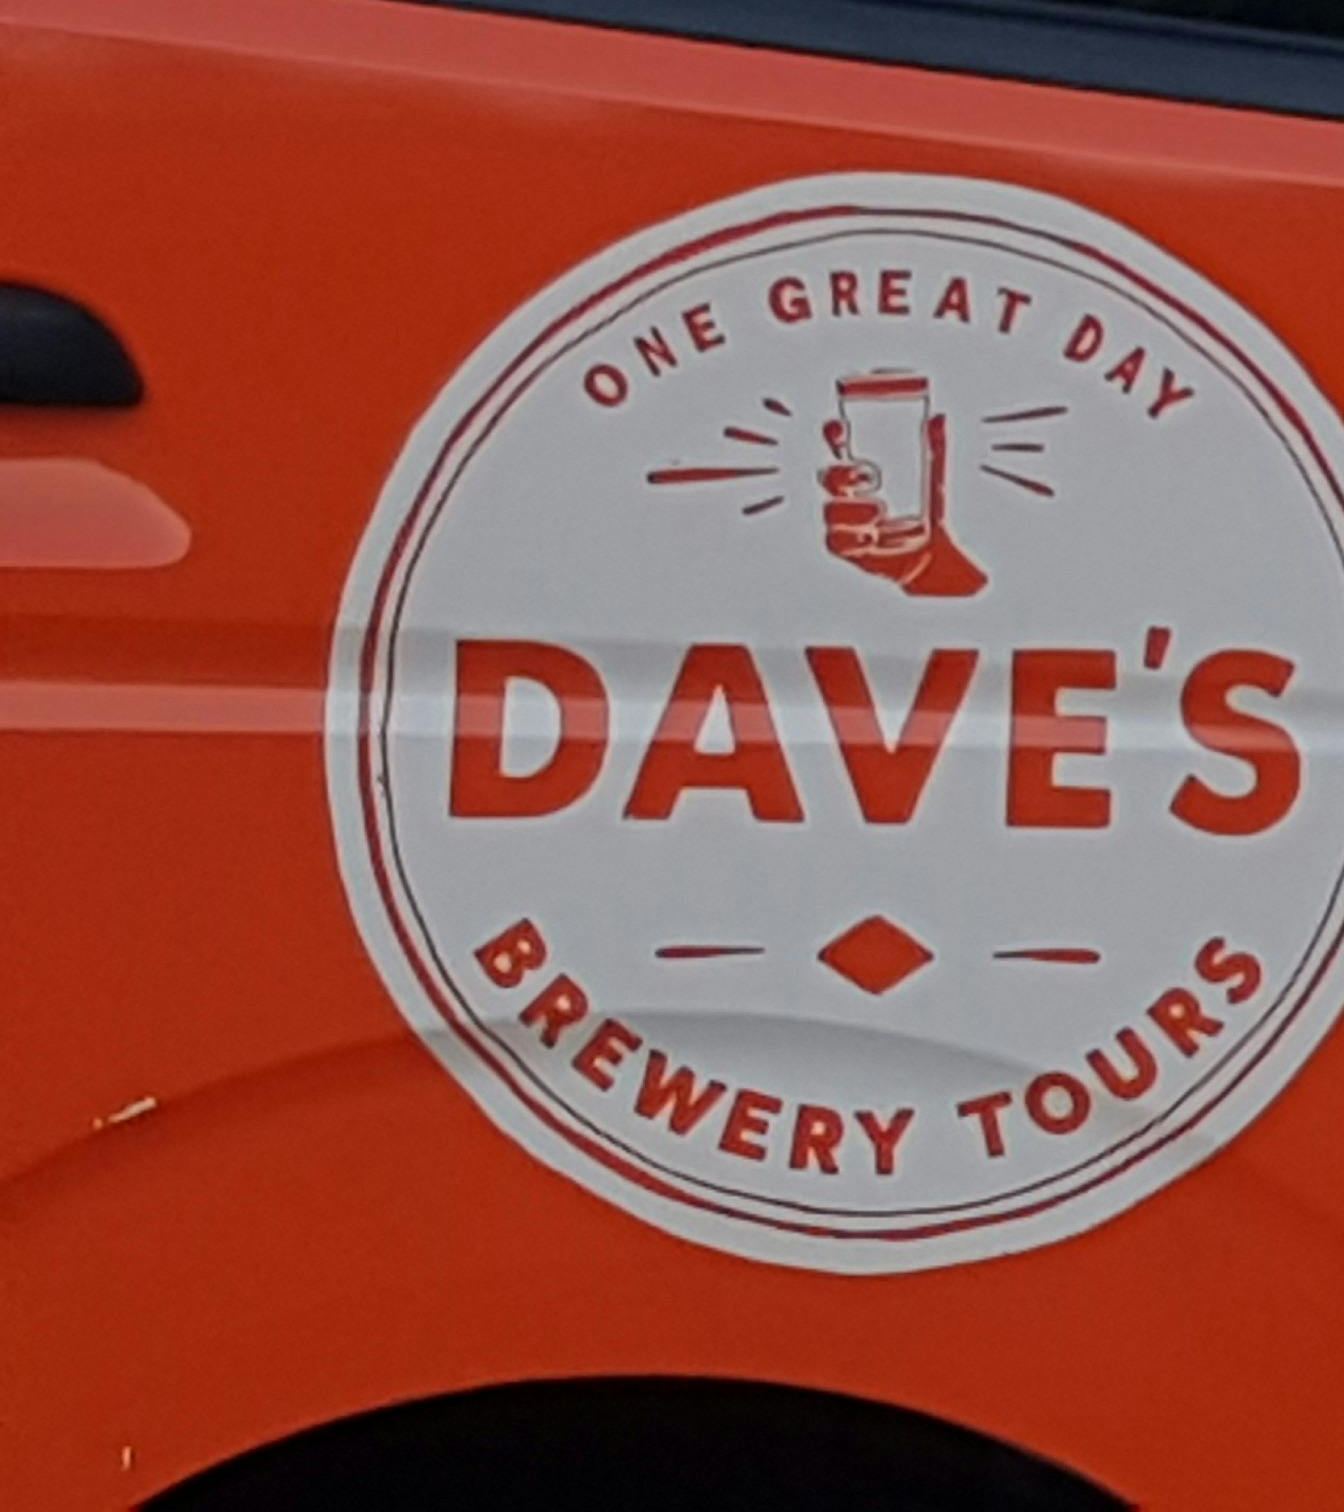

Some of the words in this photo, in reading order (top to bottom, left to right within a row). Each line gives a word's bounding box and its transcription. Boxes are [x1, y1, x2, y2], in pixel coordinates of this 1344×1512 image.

[583, 304, 725, 409] ONE
[770, 269, 1032, 333] GREAT
[1062, 315, 1196, 420] DAY
[448, 627, 1301, 836] DAVE'S
[474, 917, 915, 1176] BREWERY
[957, 936, 1263, 1159] TOURS
